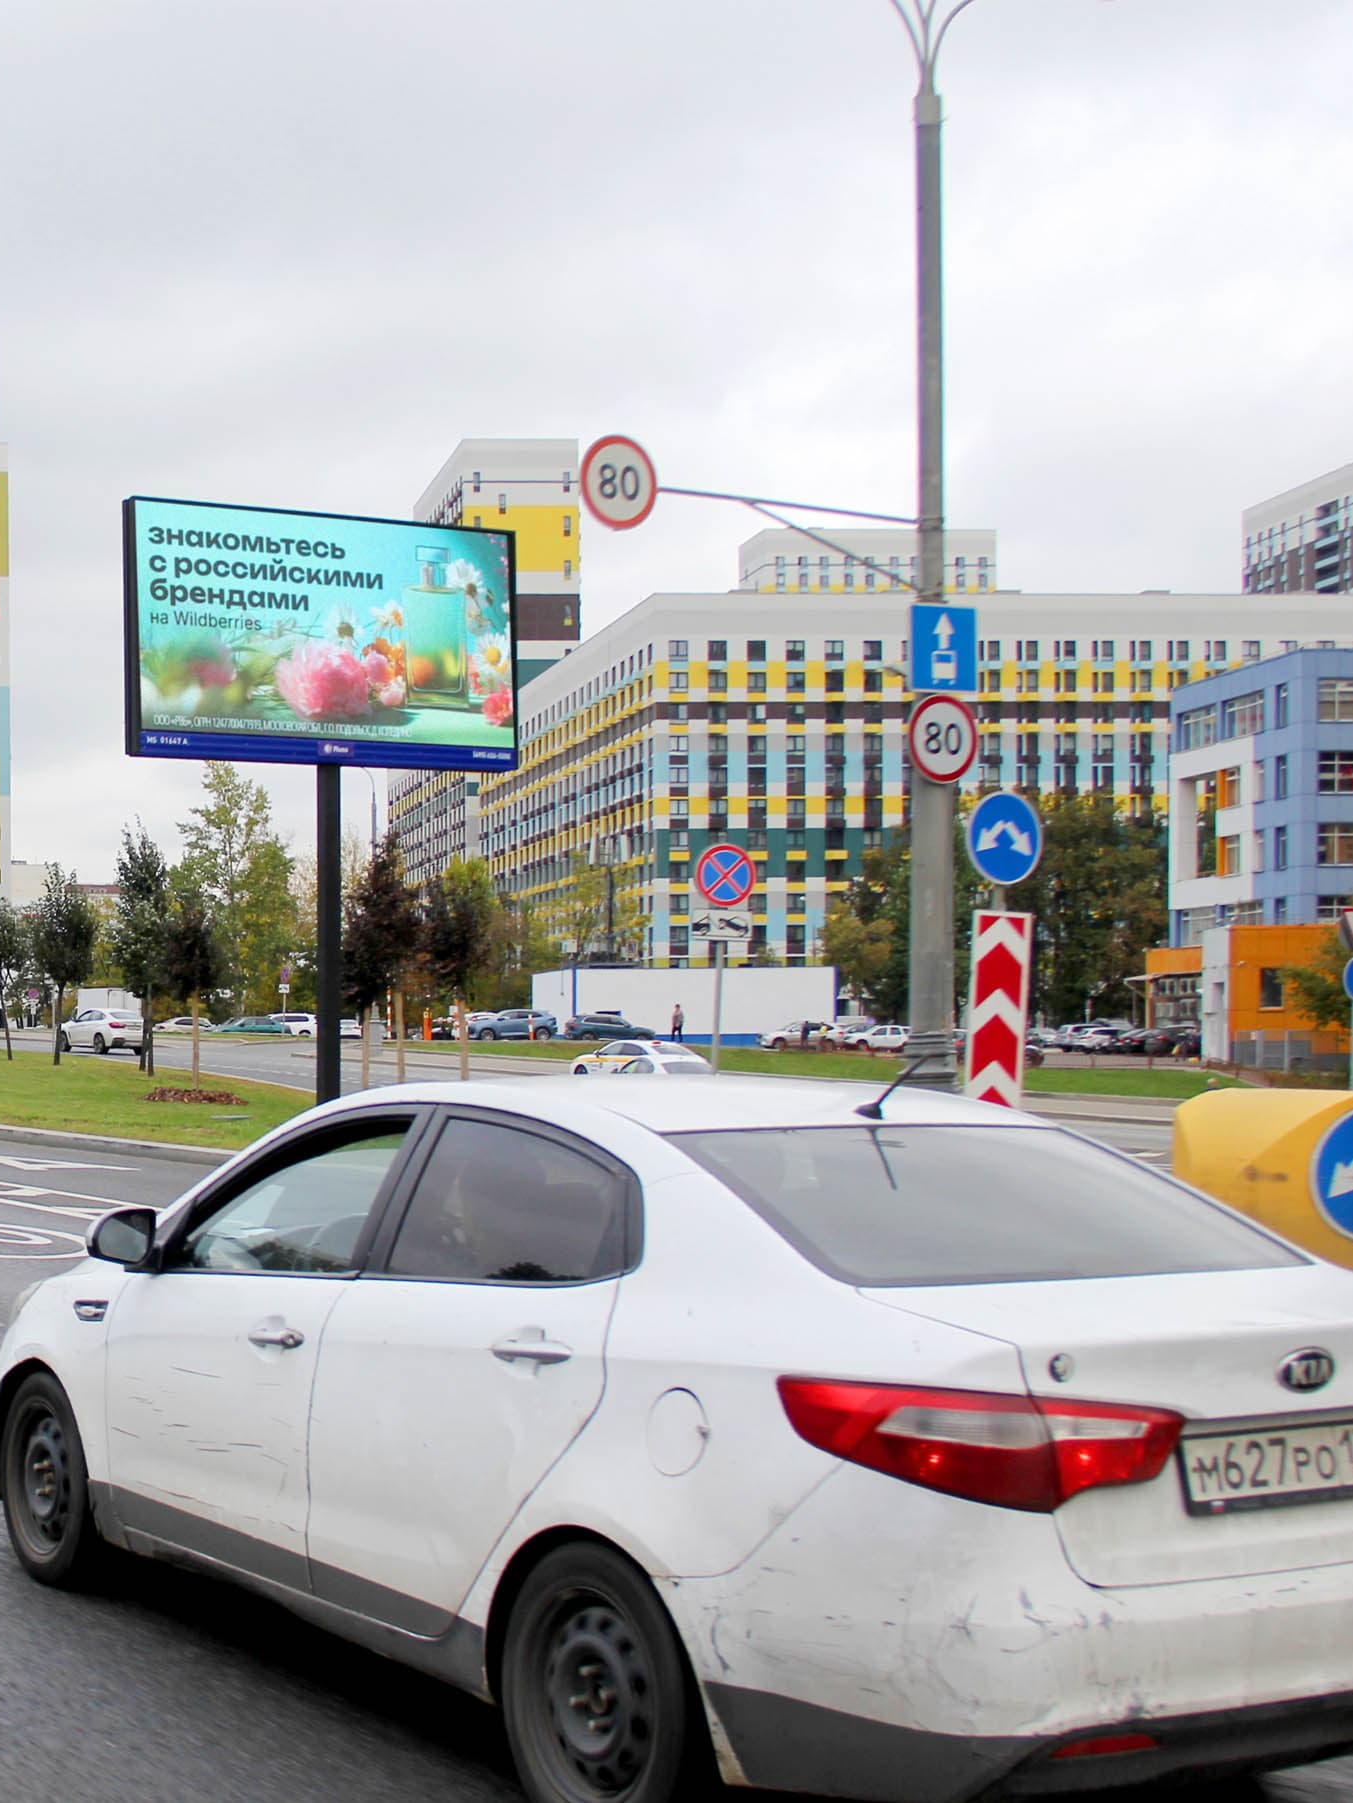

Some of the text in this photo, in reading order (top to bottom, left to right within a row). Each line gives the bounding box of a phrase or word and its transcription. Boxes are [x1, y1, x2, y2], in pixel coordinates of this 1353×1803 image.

[599, 463, 640, 501] 80
[148, 526, 346, 560] знакомьтесь
[148, 554, 384, 590] с российскими
[149, 578, 310, 611] брендами
[149, 611, 262, 631] на Wildberries
[925, 721, 962, 755] 80
[1290, 1359, 1331, 1385] KIA
